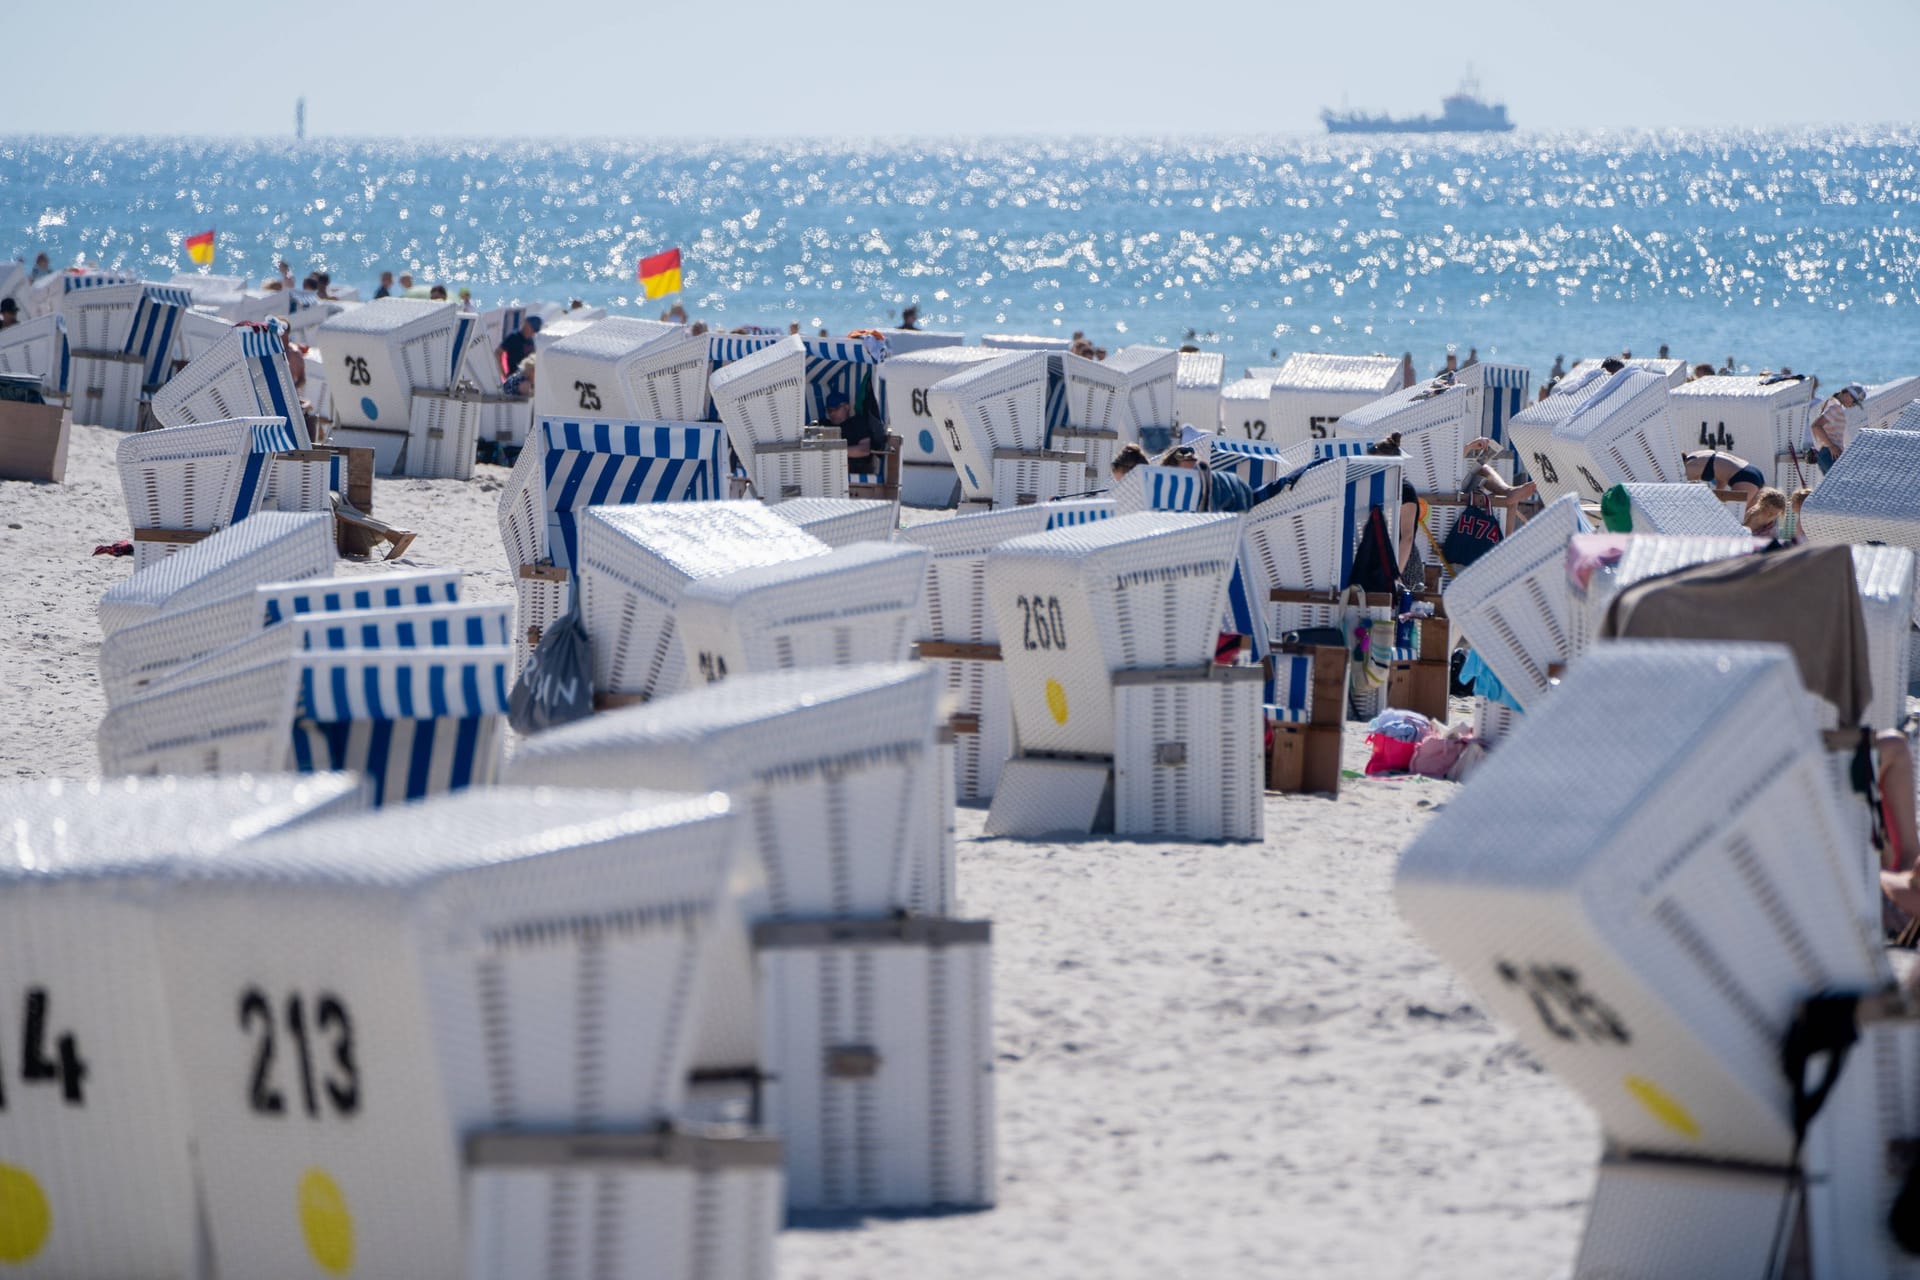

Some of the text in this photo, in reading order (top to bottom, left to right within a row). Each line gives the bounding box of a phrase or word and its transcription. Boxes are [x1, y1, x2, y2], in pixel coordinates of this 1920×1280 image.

[344, 355, 371, 386] 26
[574, 381, 602, 410] 25
[1243, 419, 1268, 440] 12
[1309, 416, 1341, 439] 57
[1699, 421, 1734, 451] 44
[1457, 515, 1499, 543] H74
[1017, 595, 1066, 650] 260
[0, 985, 88, 1110] 4
[238, 983, 361, 1117] 213
